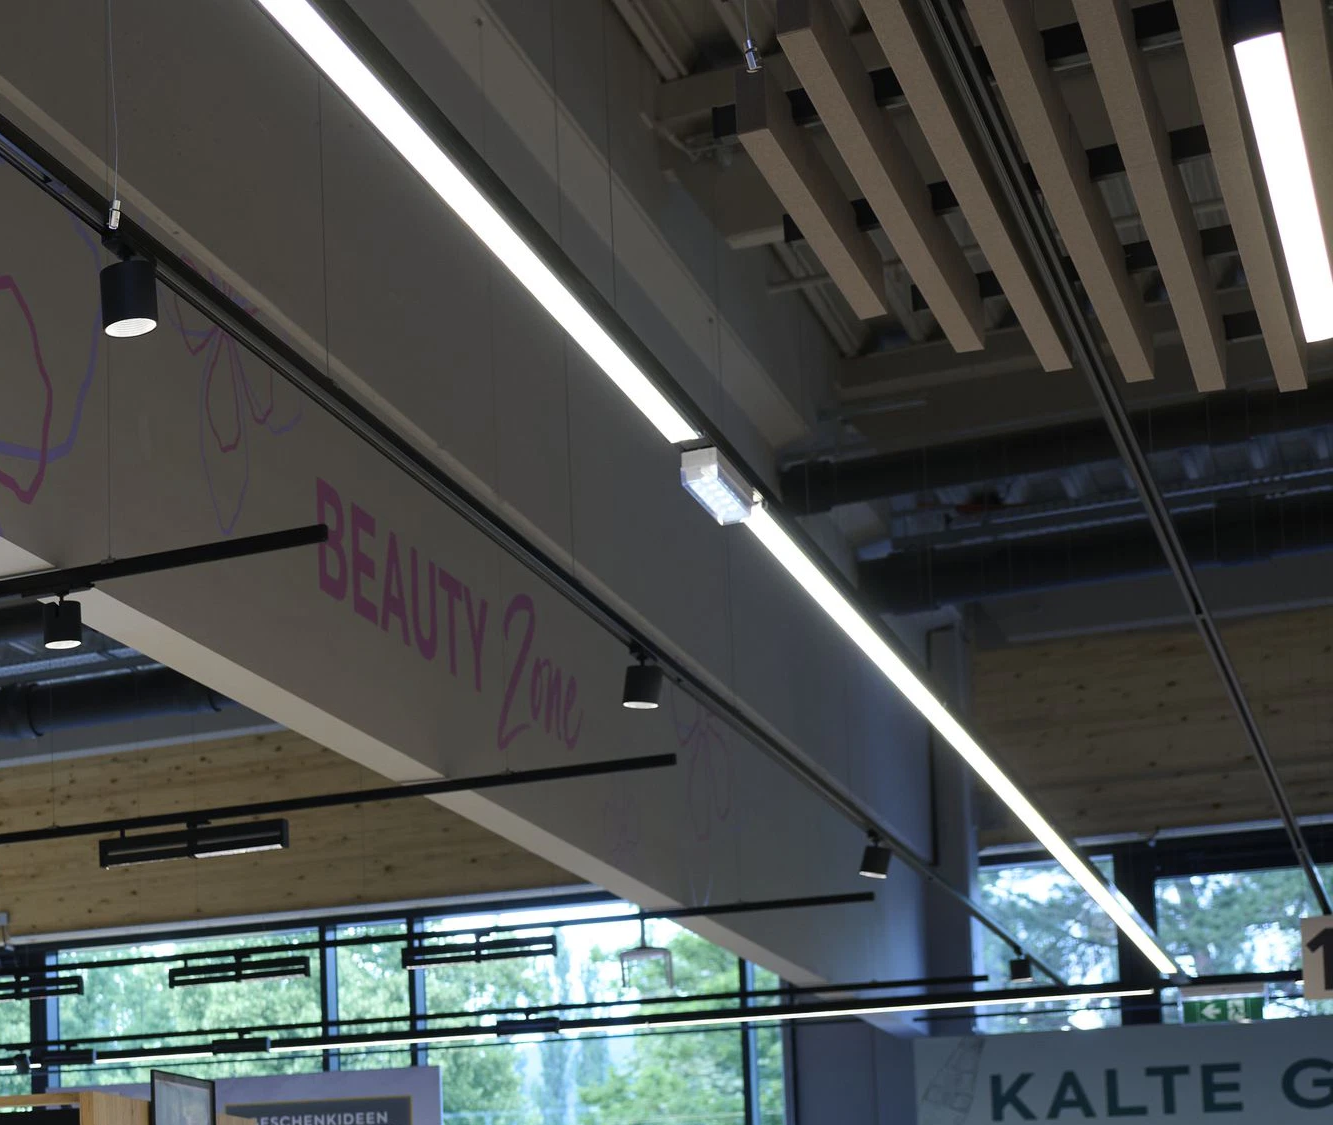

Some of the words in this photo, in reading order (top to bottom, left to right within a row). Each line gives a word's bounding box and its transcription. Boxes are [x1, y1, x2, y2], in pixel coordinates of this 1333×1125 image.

[316, 477, 488, 692] BEAUTY
[497, 594, 583, 751] Zone
[990, 1062, 1244, 1122] KALTE
